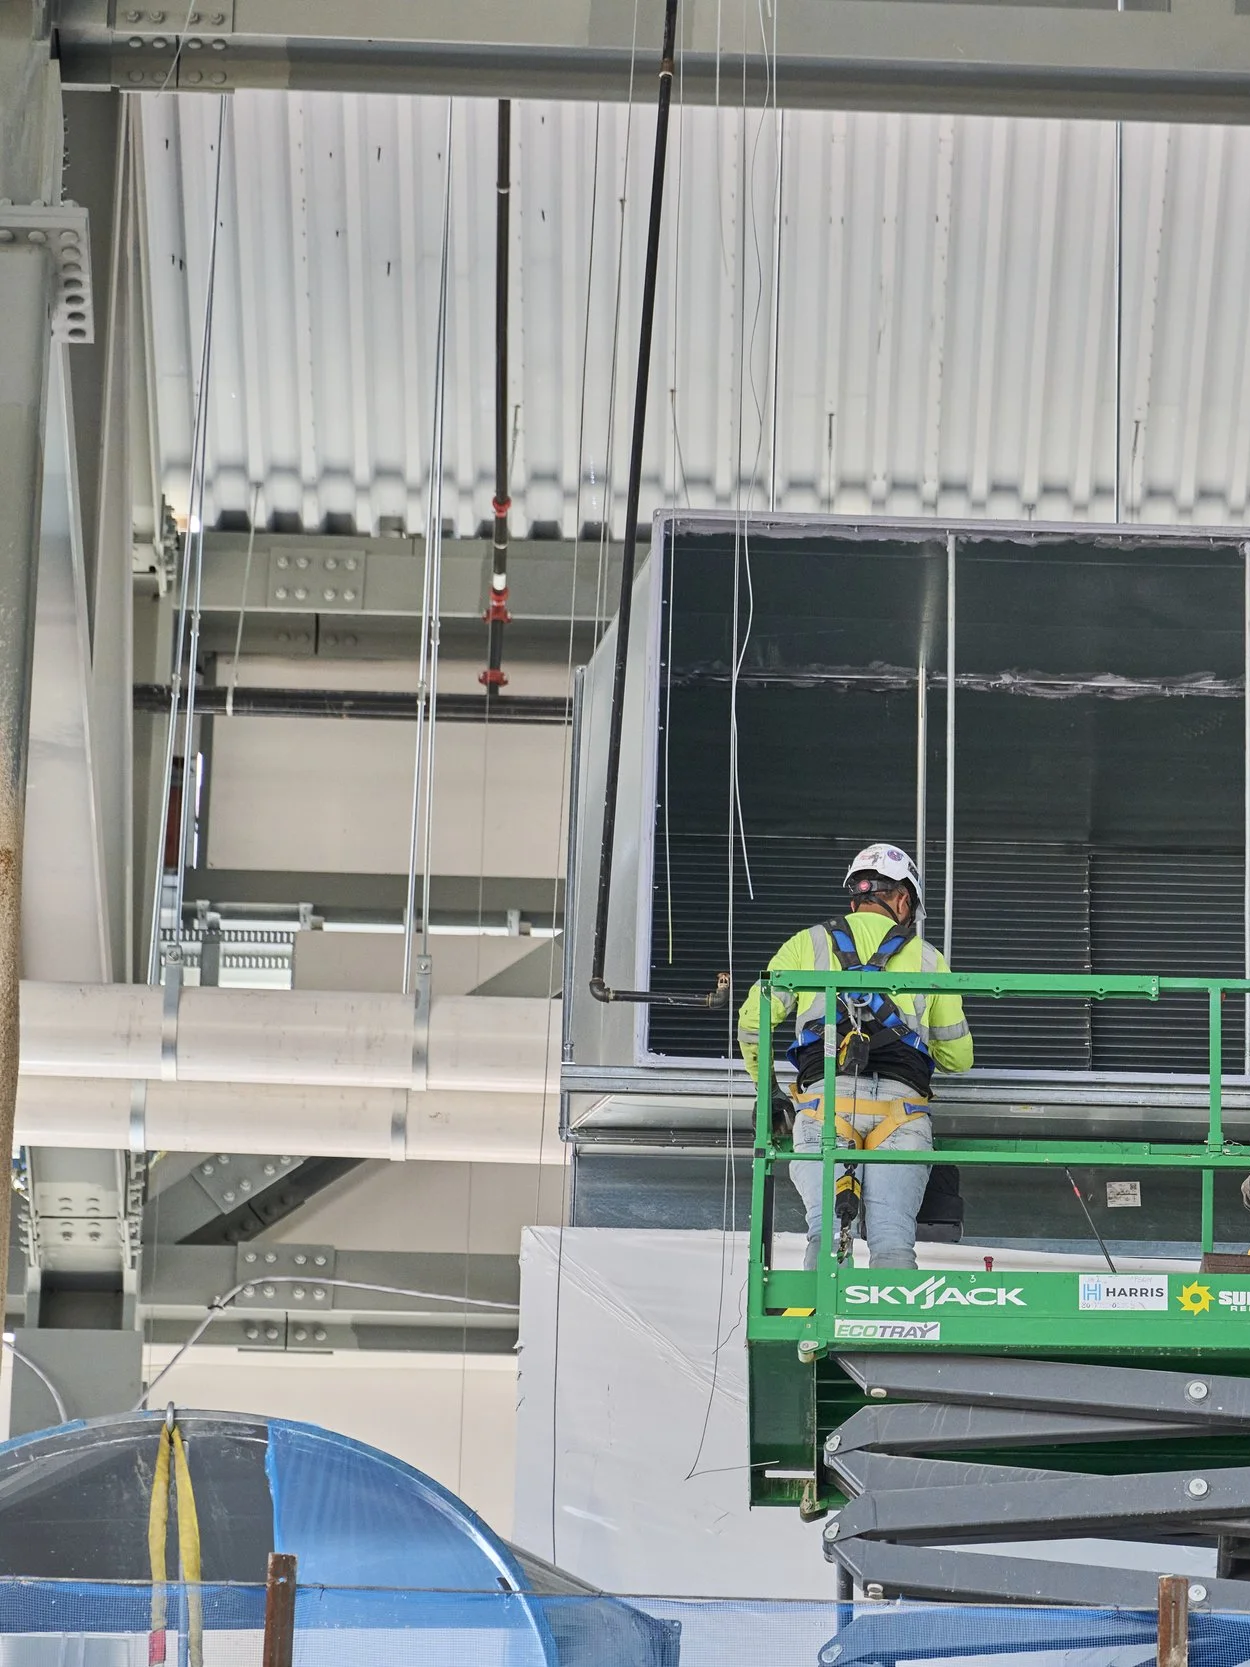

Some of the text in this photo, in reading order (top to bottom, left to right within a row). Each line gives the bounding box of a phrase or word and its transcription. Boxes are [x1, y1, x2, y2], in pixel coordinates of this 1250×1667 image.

[844, 1275, 1028, 1310] SKYJACK
[1105, 1287, 1165, 1298] HARRIS
[837, 1323, 939, 1339] ECOTRAY
